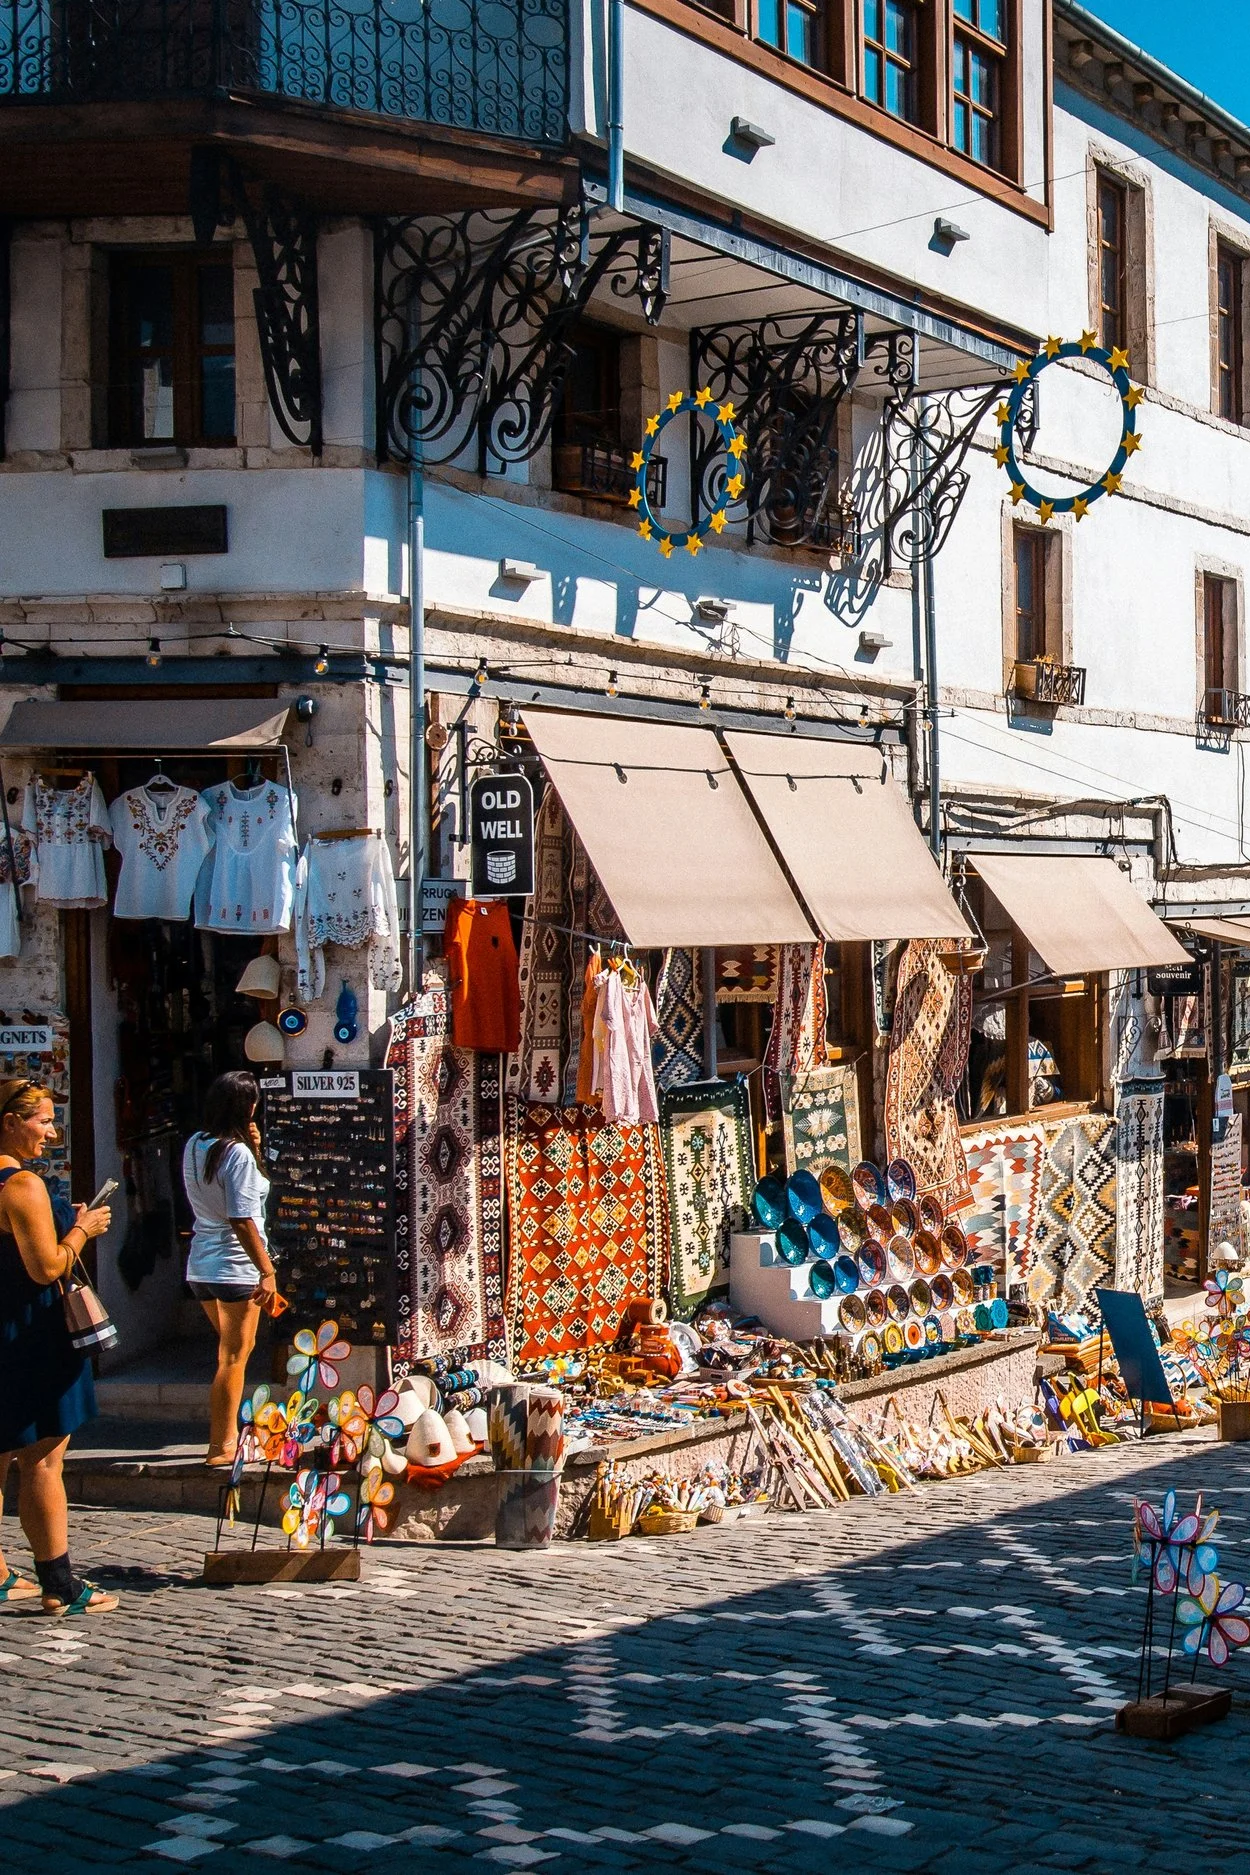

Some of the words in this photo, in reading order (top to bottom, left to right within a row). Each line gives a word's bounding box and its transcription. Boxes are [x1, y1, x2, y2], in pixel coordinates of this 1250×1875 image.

[481, 790, 521, 810] OLD
[480, 820, 523, 839] WELL
[1155, 970, 1192, 979] Souvenir
[0, 1030, 47, 1045] GNETS
[297, 1076, 334, 1091] SILVER
[336, 1076, 355, 1091] 925
